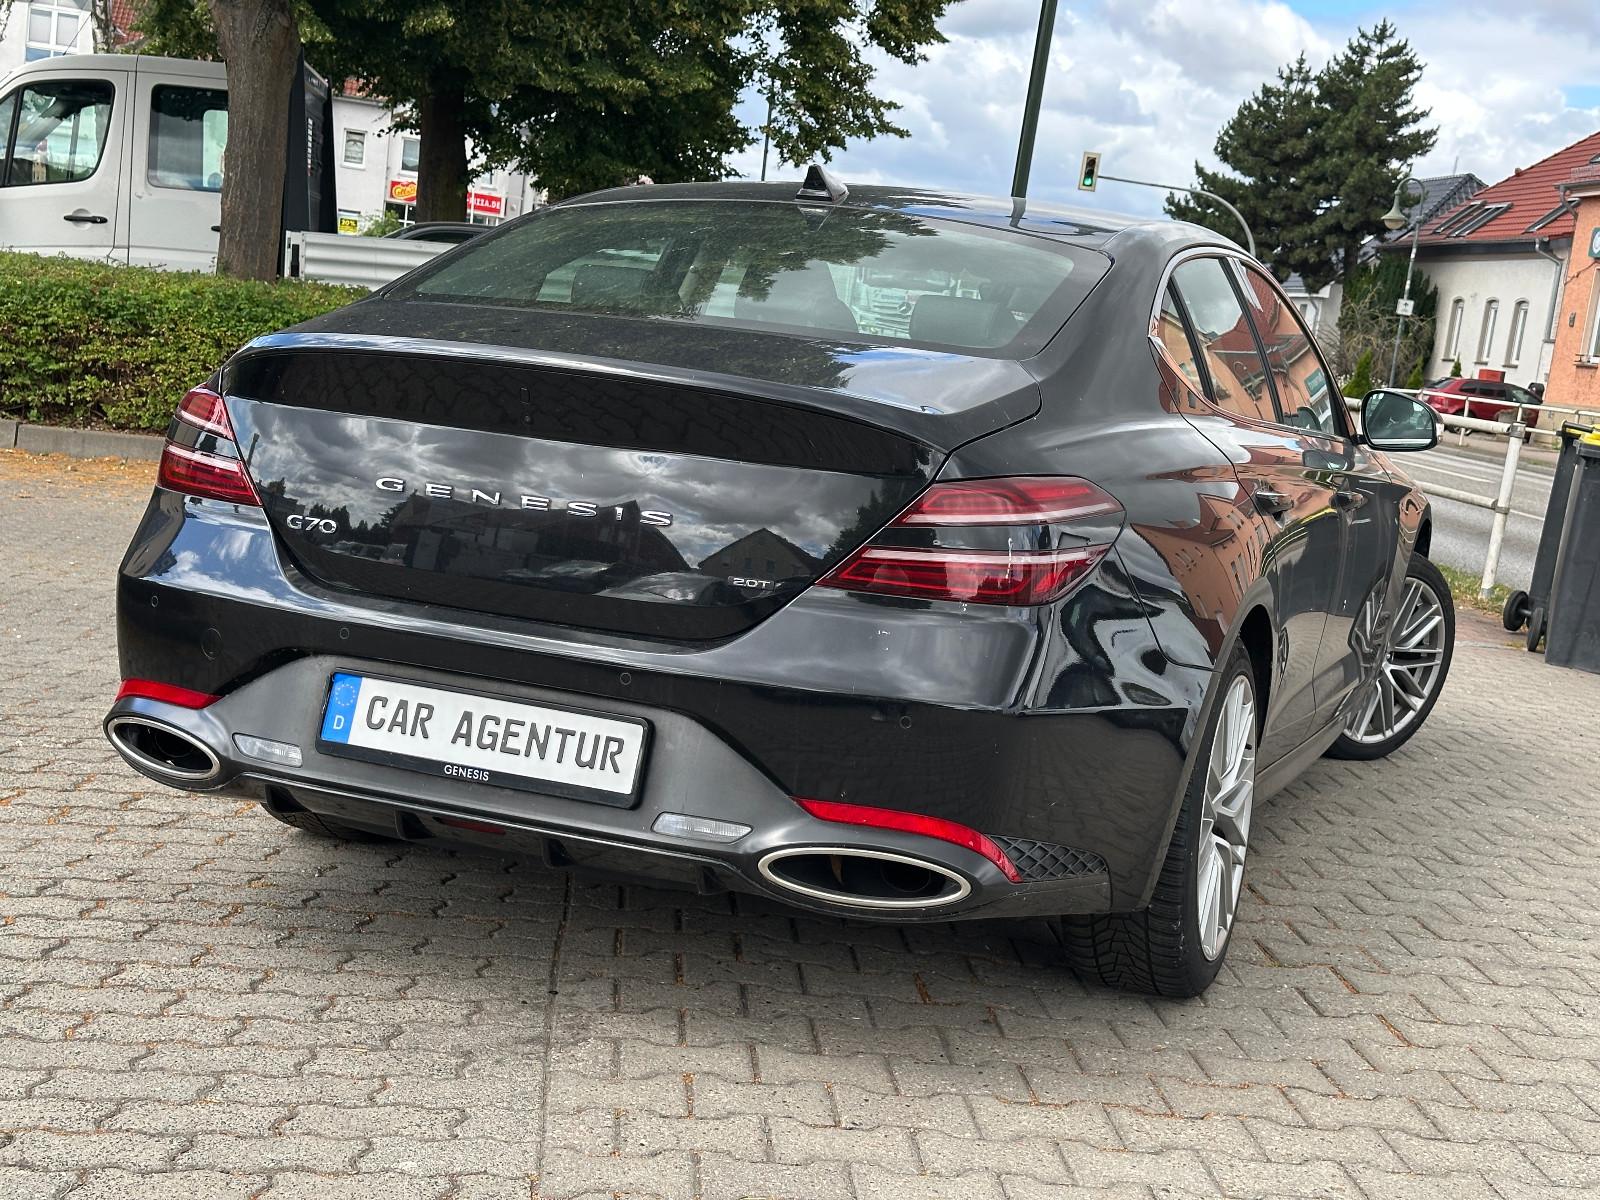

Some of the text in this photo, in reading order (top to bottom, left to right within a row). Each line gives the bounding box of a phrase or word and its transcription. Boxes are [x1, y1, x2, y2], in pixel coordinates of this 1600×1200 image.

[375, 477, 673, 527] GENESIS
[286, 514, 337, 534] G70
[733, 577, 771, 589] 2.0T
[332, 715, 345, 731] D
[365, 695, 625, 774] CAR AGENTUR
[443, 764, 490, 781] GENESIS
